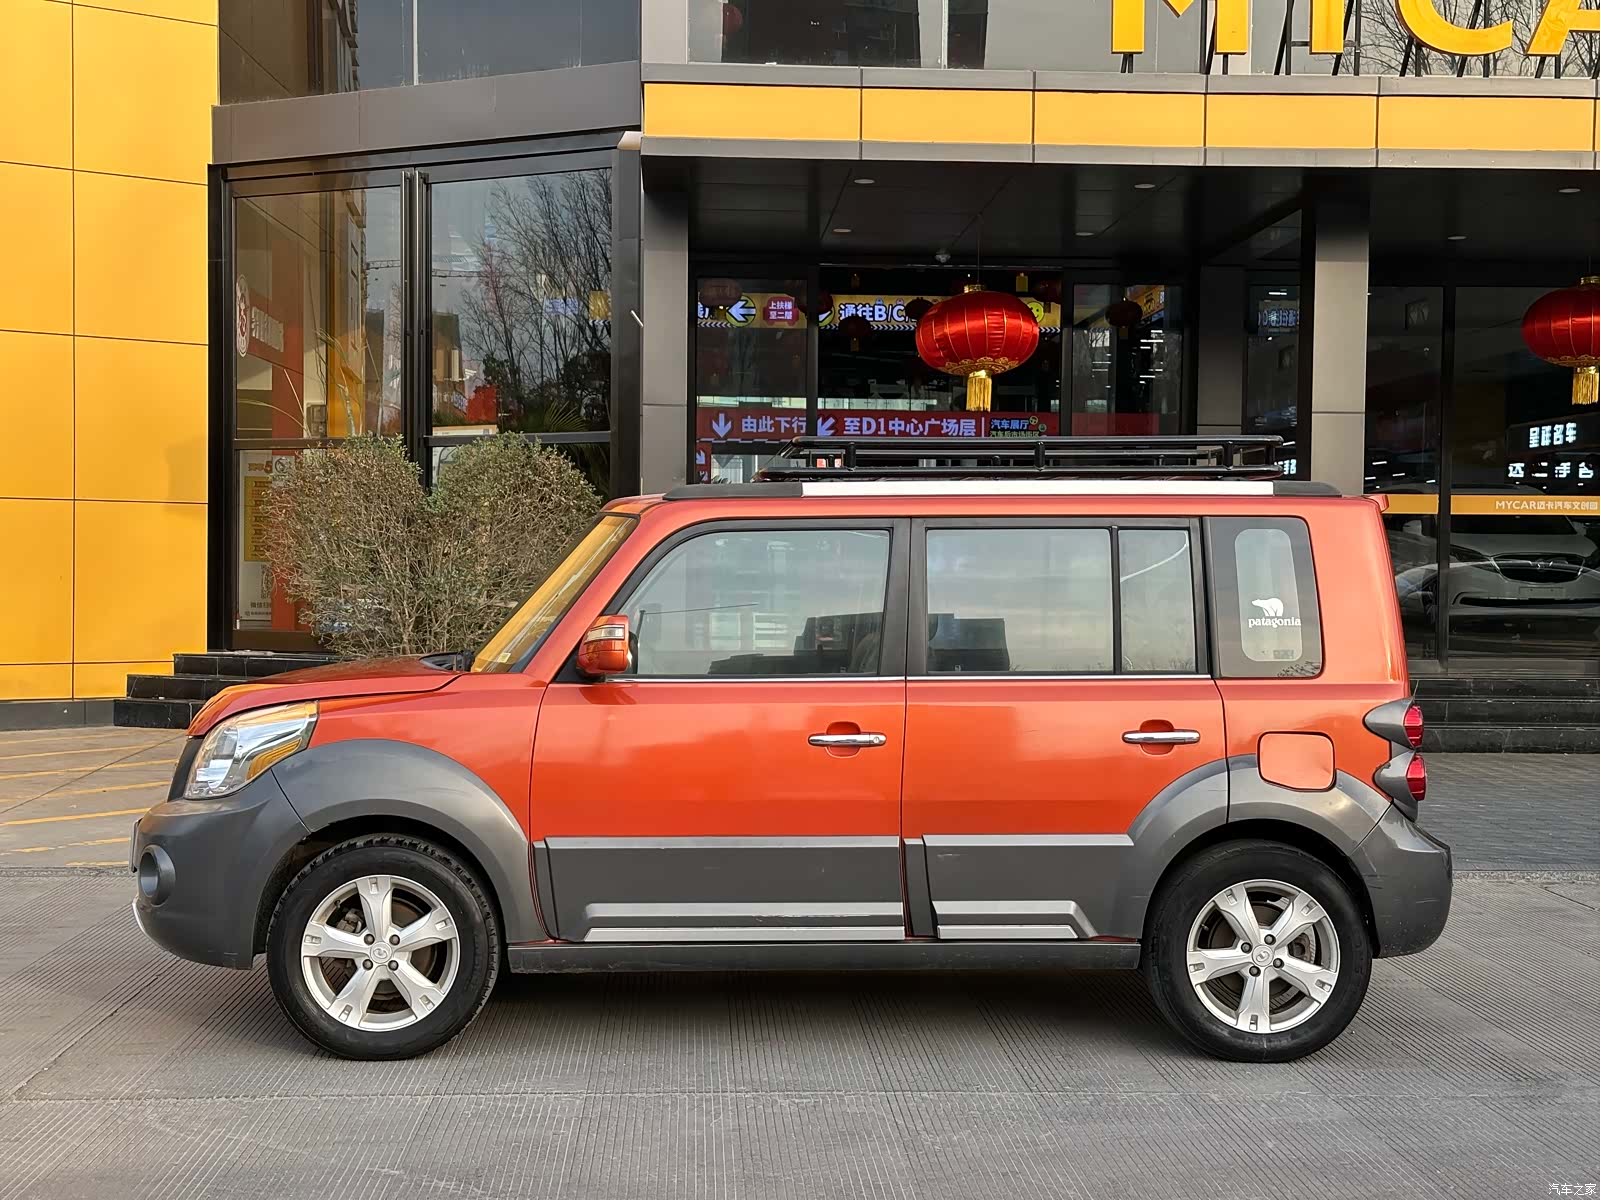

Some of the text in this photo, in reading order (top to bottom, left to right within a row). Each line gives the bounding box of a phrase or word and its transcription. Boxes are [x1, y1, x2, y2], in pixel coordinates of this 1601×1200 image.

[840, 303, 917, 322] 通往B/C
[742, 416, 806, 433] 由此下行
[843, 416, 976, 436] 至D1中心广场层
[991, 419, 1029, 430] 汽车展厅
[1248, 616, 1302, 628] patagonia
